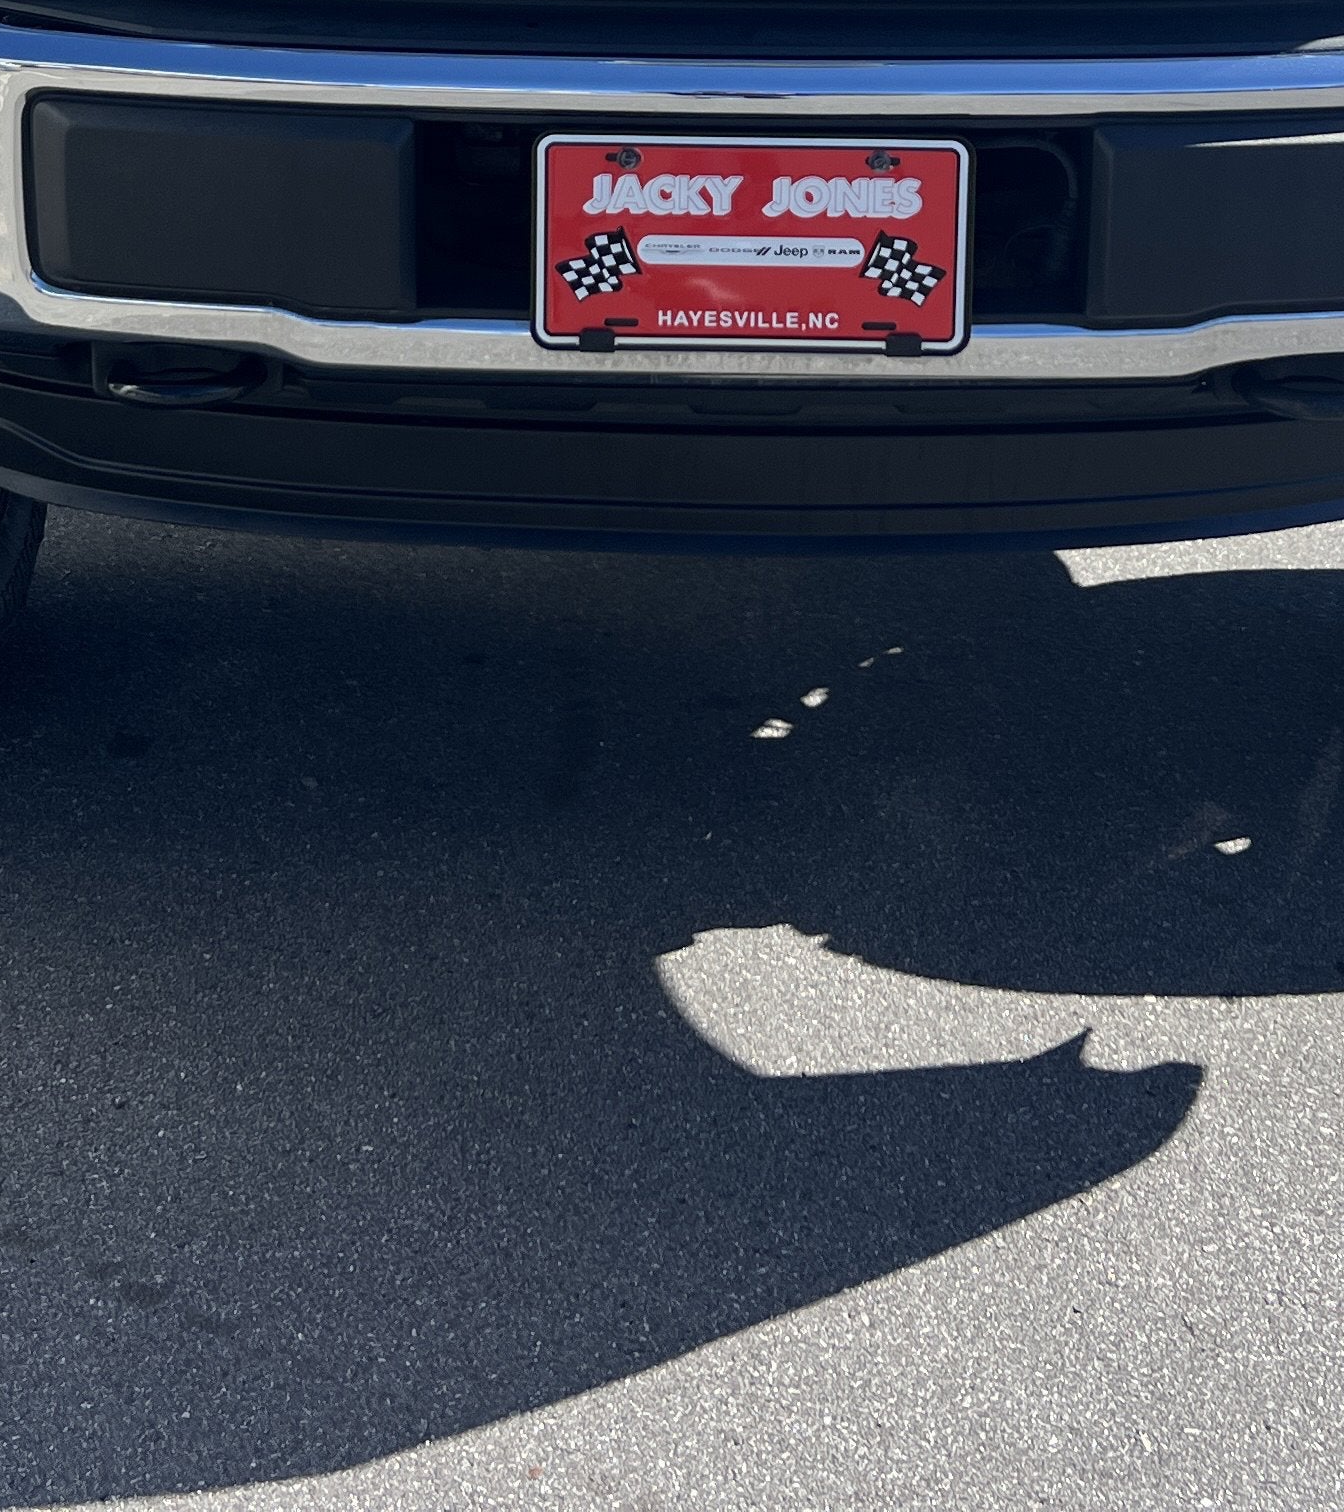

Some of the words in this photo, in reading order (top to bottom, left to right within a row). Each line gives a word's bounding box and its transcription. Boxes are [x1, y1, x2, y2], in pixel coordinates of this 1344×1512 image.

[582, 173, 744, 217] JACKY
[762, 175, 923, 220] JONES
[774, 245, 809, 258] Jeep
